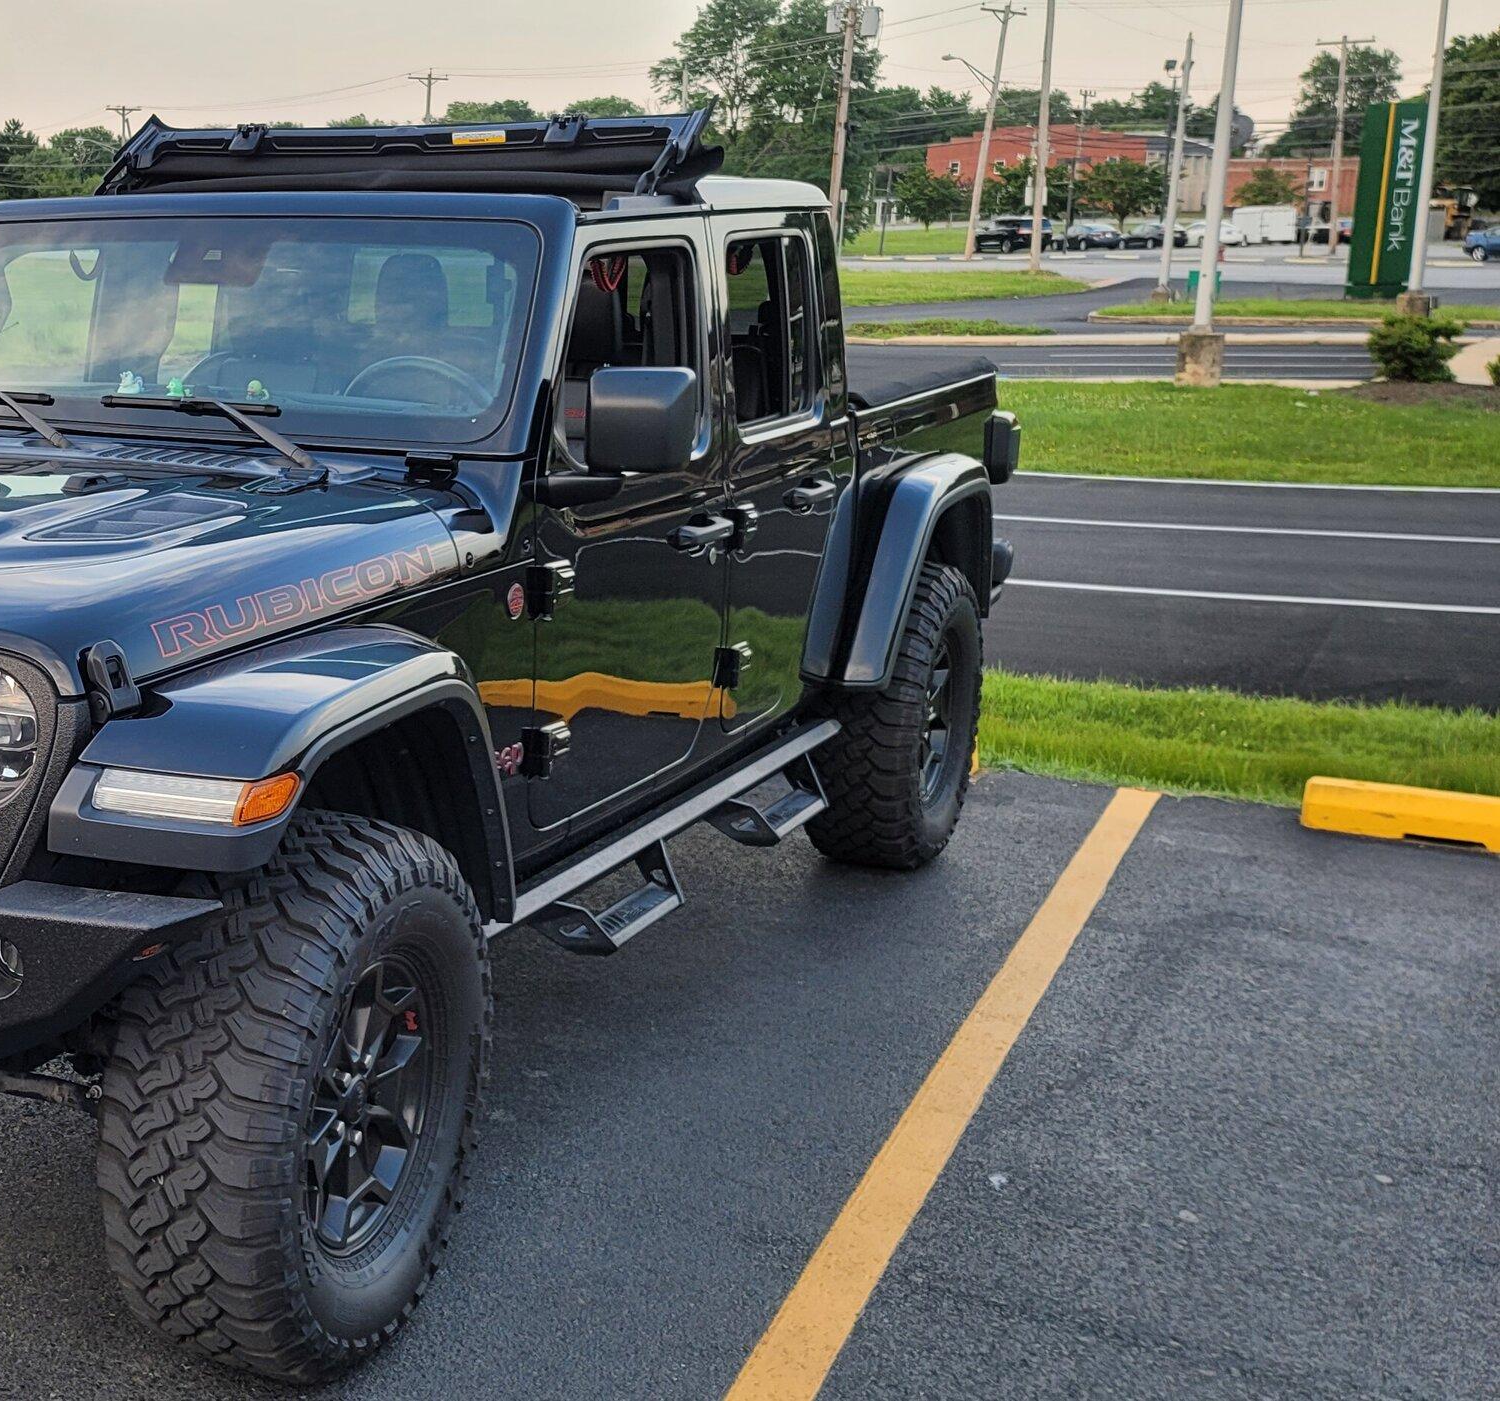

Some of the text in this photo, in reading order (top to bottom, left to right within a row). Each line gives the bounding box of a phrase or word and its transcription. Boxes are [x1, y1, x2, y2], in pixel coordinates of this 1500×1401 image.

[1386, 118, 1420, 251] M&T Bank
[150, 544, 436, 658] RUBICON
